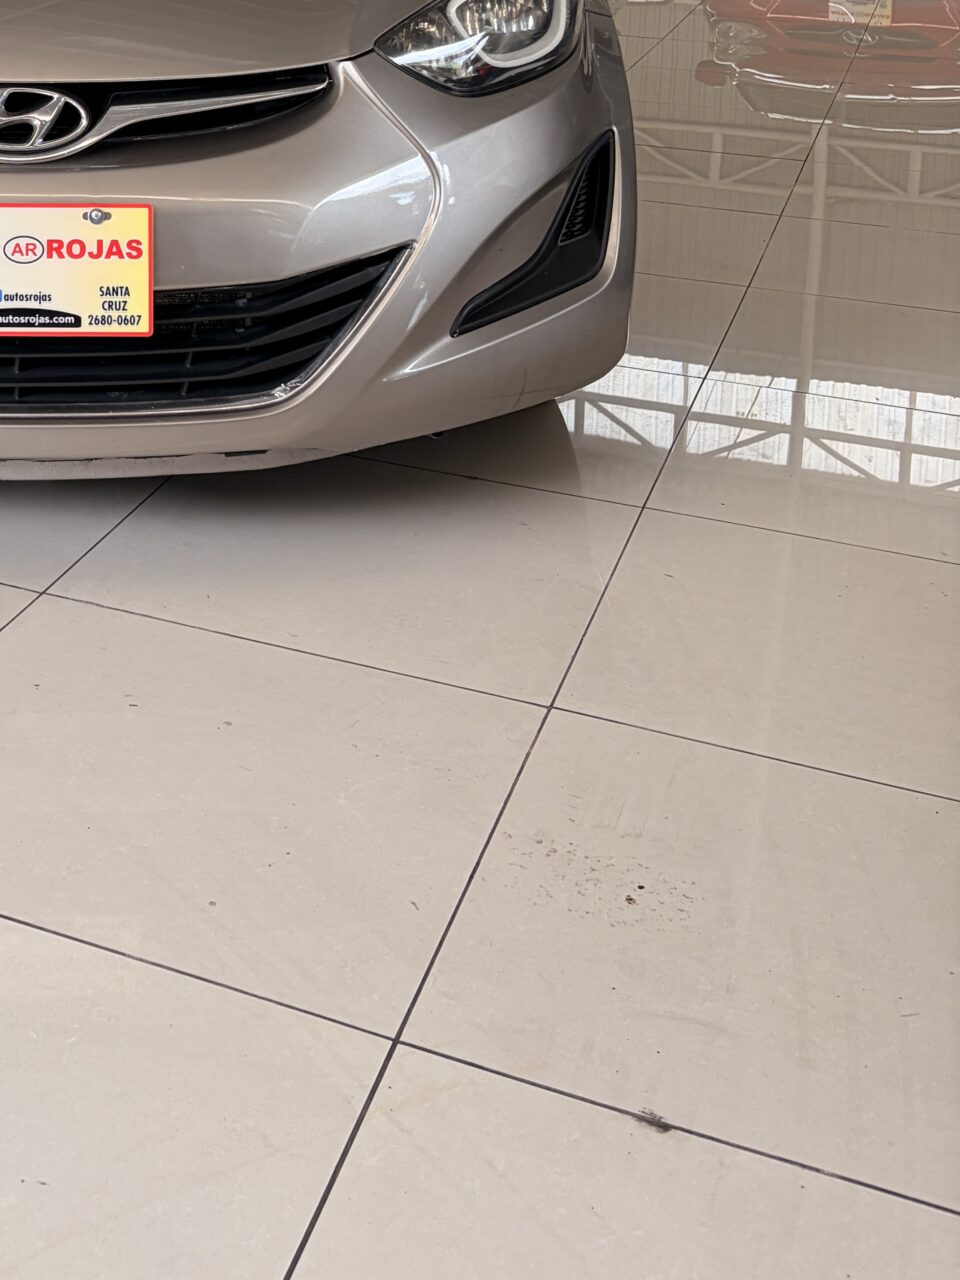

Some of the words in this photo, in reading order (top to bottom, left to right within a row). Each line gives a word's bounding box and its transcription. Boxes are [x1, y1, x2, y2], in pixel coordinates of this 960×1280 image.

[11, 242, 38, 258] AR
[46, 239, 144, 260] ROJAS
[99, 286, 131, 297] SANTA
[3, 292, 52, 305] autosrojas
[101, 301, 128, 312] CRUZ
[88, 315, 142, 327] 2680-0607
